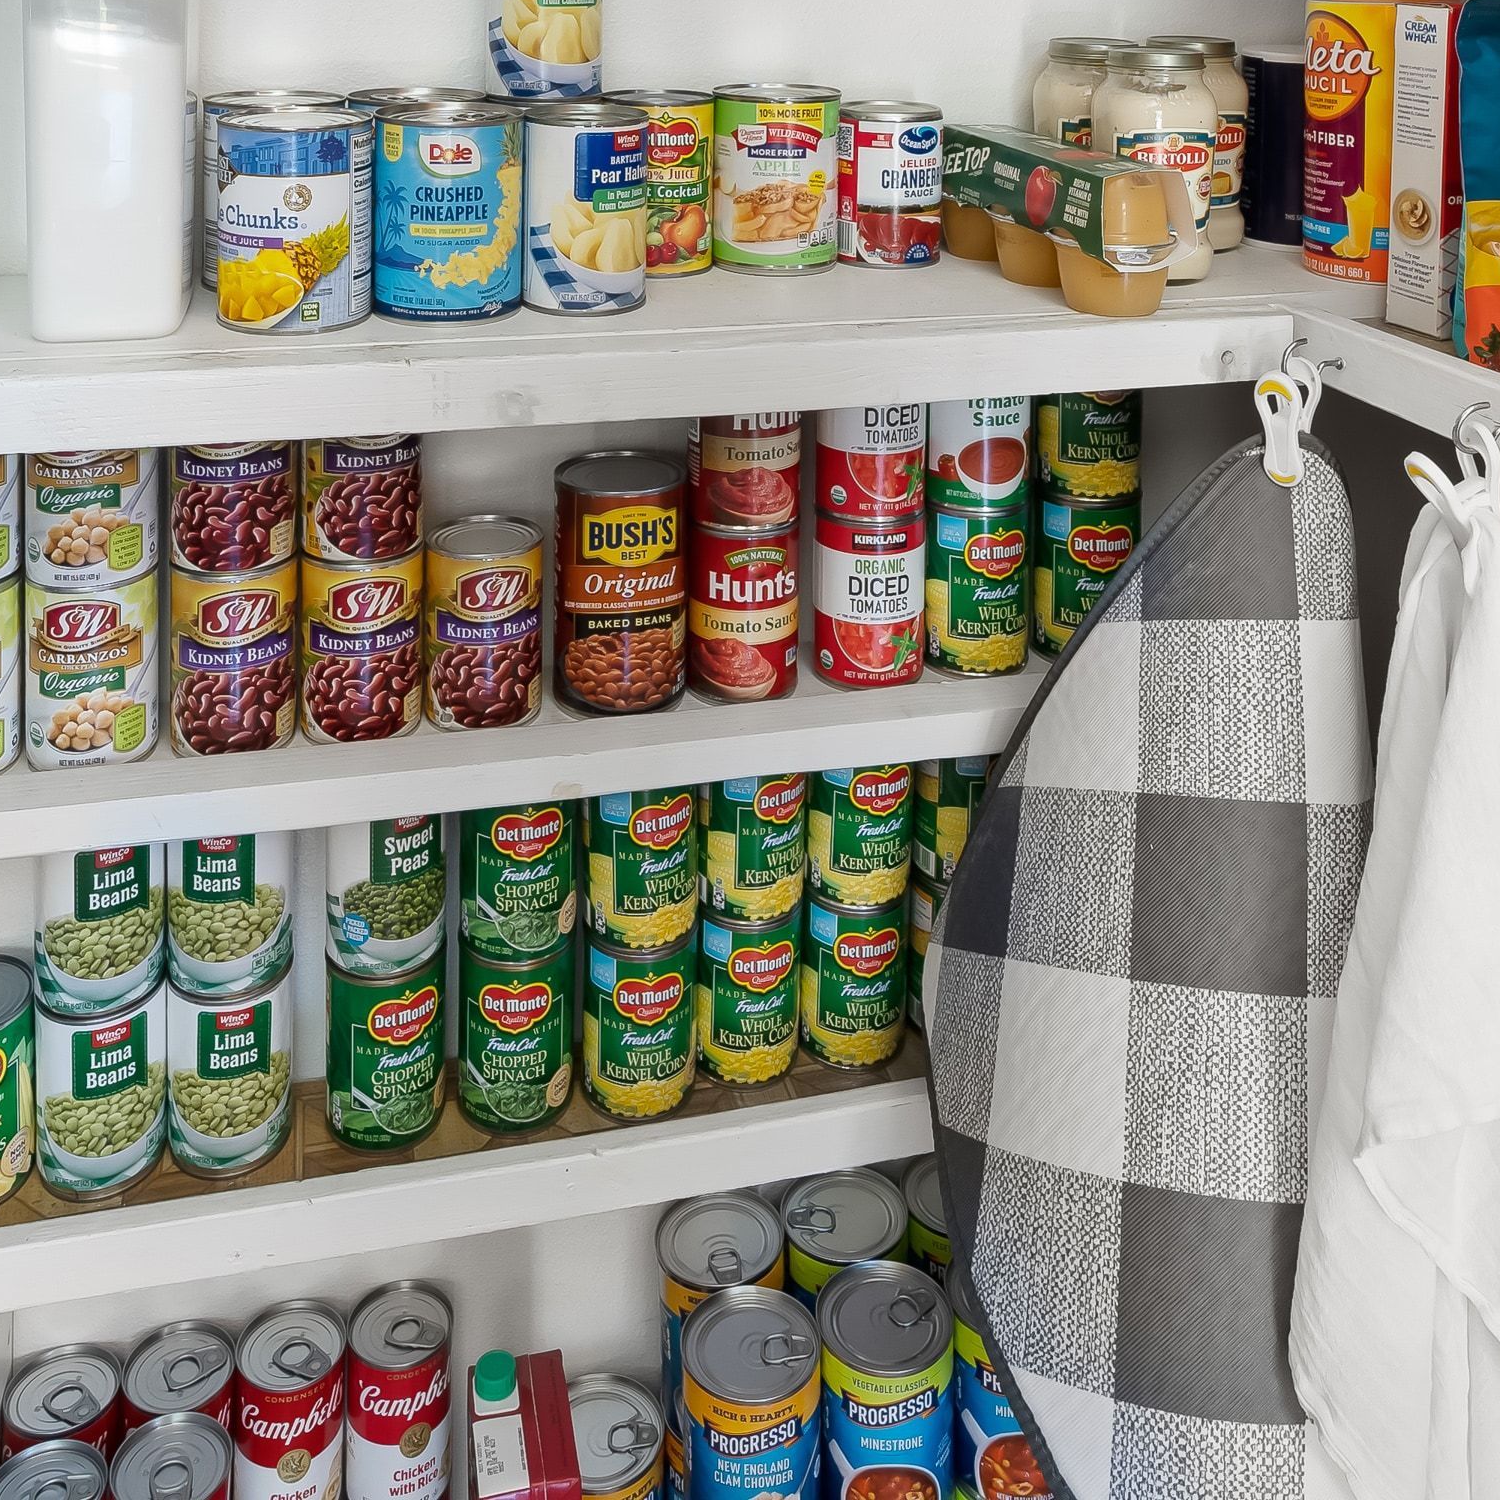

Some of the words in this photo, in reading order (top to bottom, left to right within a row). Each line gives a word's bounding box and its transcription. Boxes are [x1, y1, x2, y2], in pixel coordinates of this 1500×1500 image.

[1405, 21, 1436, 33] CREAM
[759, 109, 776, 117] 10%
[777, 109, 801, 118] MORE
[802, 108, 822, 119] FRUIT
[656, 133, 695, 145] Monte
[769, 128, 818, 145] WILDERNESS
[1318, 132, 1355, 147] FIBER
[429, 144, 472, 161] Dole
[652, 150, 678, 159] Quality
[751, 149, 777, 157] MORE
[777, 149, 804, 157] FRUIT
[964, 147, 990, 171] TOP
[1137, 152, 1205, 165] BERTOLLI
[752, 161, 800, 171] APPLE
[900, 158, 937, 168] JELLIED
[993, 161, 1020, 181] ORIGINAL
[668, 169, 694, 180] JUICE
[415, 186, 483, 201] CRUSHED
[657, 183, 702, 197] Cocktail
[904, 189, 934, 198] SAUCE
[226, 205, 299, 230] Chunks
[410, 204, 488, 221] PINEAPPLE
[239, 237, 264, 247] JUICE
[1348, 266, 1362, 277] 660
[588, 515, 674, 550] BUSH'S
[854, 533, 906, 545] KIRKLAND
[621, 550, 648, 561] BEST
[730, 554, 748, 564] 100%
[750, 551, 783, 561] NATURAL
[971, 546, 992, 560] Del
[993, 543, 1023, 559] Monte
[855, 558, 905, 574] ORGANIC
[988, 561, 1011, 572] Quality
[584, 565, 676, 598] Original
[849, 575, 909, 597] DICED
[849, 598, 908, 614] TOMATOES
[978, 606, 1017, 621] WHOLE
[206, 596, 271, 633] S&W
[588, 618, 629, 629] BAKED
[635, 613, 671, 627] BEANS
[702, 613, 761, 633] Tomato
[958, 619, 1002, 635] KERNEL
[188, 648, 243, 666] KIDNEY
[247, 639, 288, 662] BEANS
[384, 824, 434, 857] Sweet
[390, 854, 429, 877] Peas
[220, 1011, 250, 1024] WinCo
[214, 1031, 255, 1051] Lima
[210, 1049, 258, 1070] Beans
[481, 1050, 547, 1071] CHOPPED
[483, 1064, 545, 1082] SPINACH
[852, 1377, 893, 1393] VEGETABLE
[895, 1377, 928, 1393] CLASSICS
[711, 1419, 797, 1455] PROGRESSO
[860, 1436, 923, 1450] MINESTRONE
[393, 1457, 436, 1482] Chicken
[717, 1459, 740, 1473] NEW
[744, 1458, 790, 1474] ENGLAND
[714, 1471, 741, 1487] CLAM
[744, 1469, 793, 1488] CHOWDER
[389, 1481, 415, 1497] with
